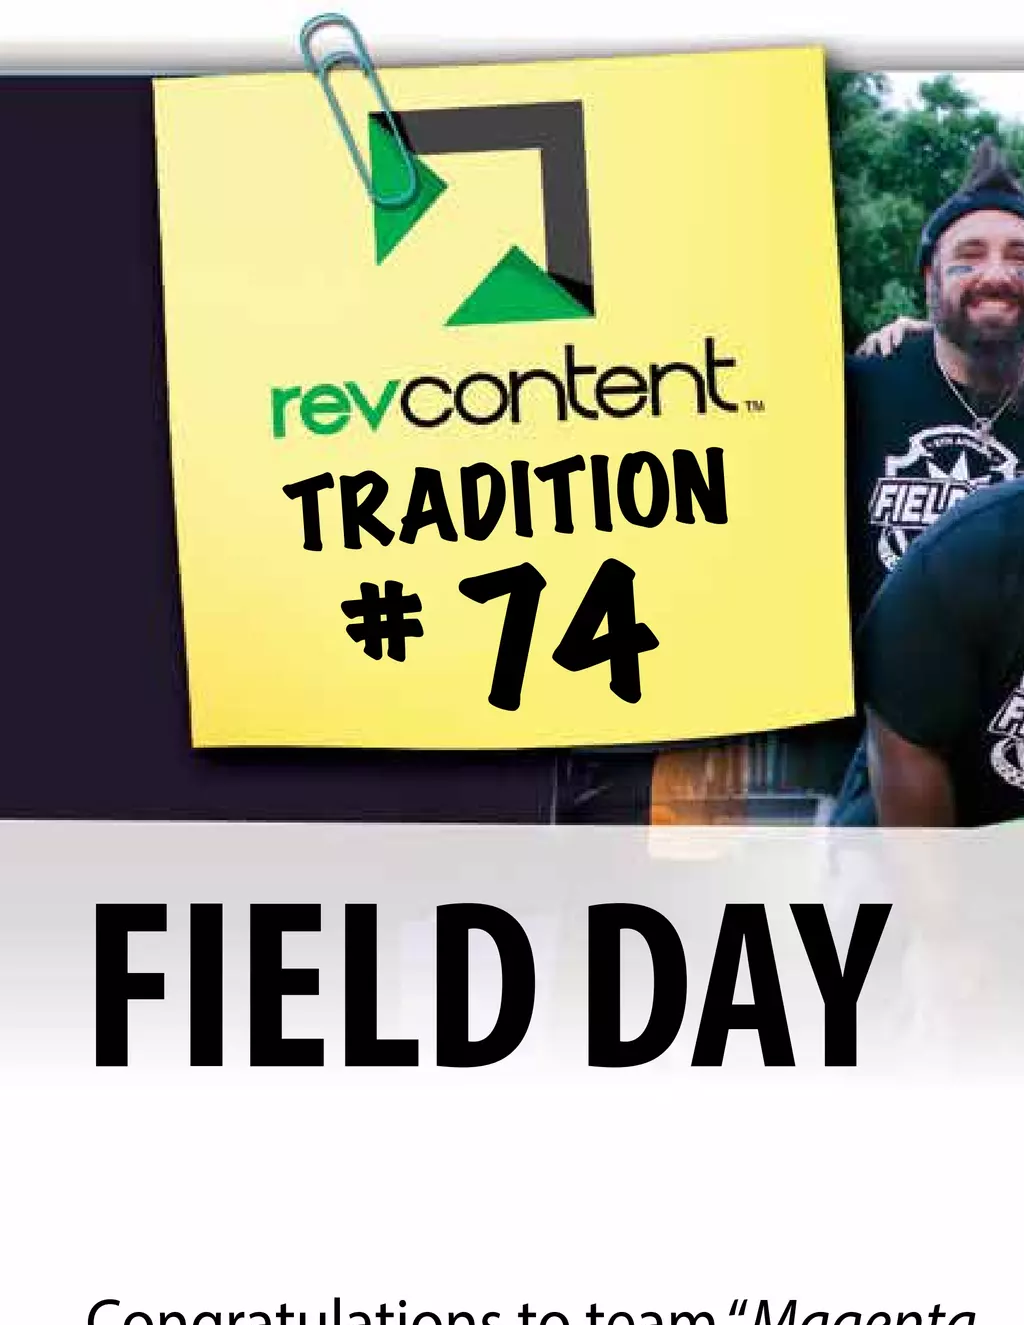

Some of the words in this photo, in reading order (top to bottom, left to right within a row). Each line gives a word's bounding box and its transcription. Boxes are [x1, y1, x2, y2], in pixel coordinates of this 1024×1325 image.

[282, 447, 727, 552] TRADITION
[341, 580, 424, 662] #
[459, 558, 659, 712] 74
[96, 903, 535, 1067] FIELD
[589, 903, 893, 1067] DAY
